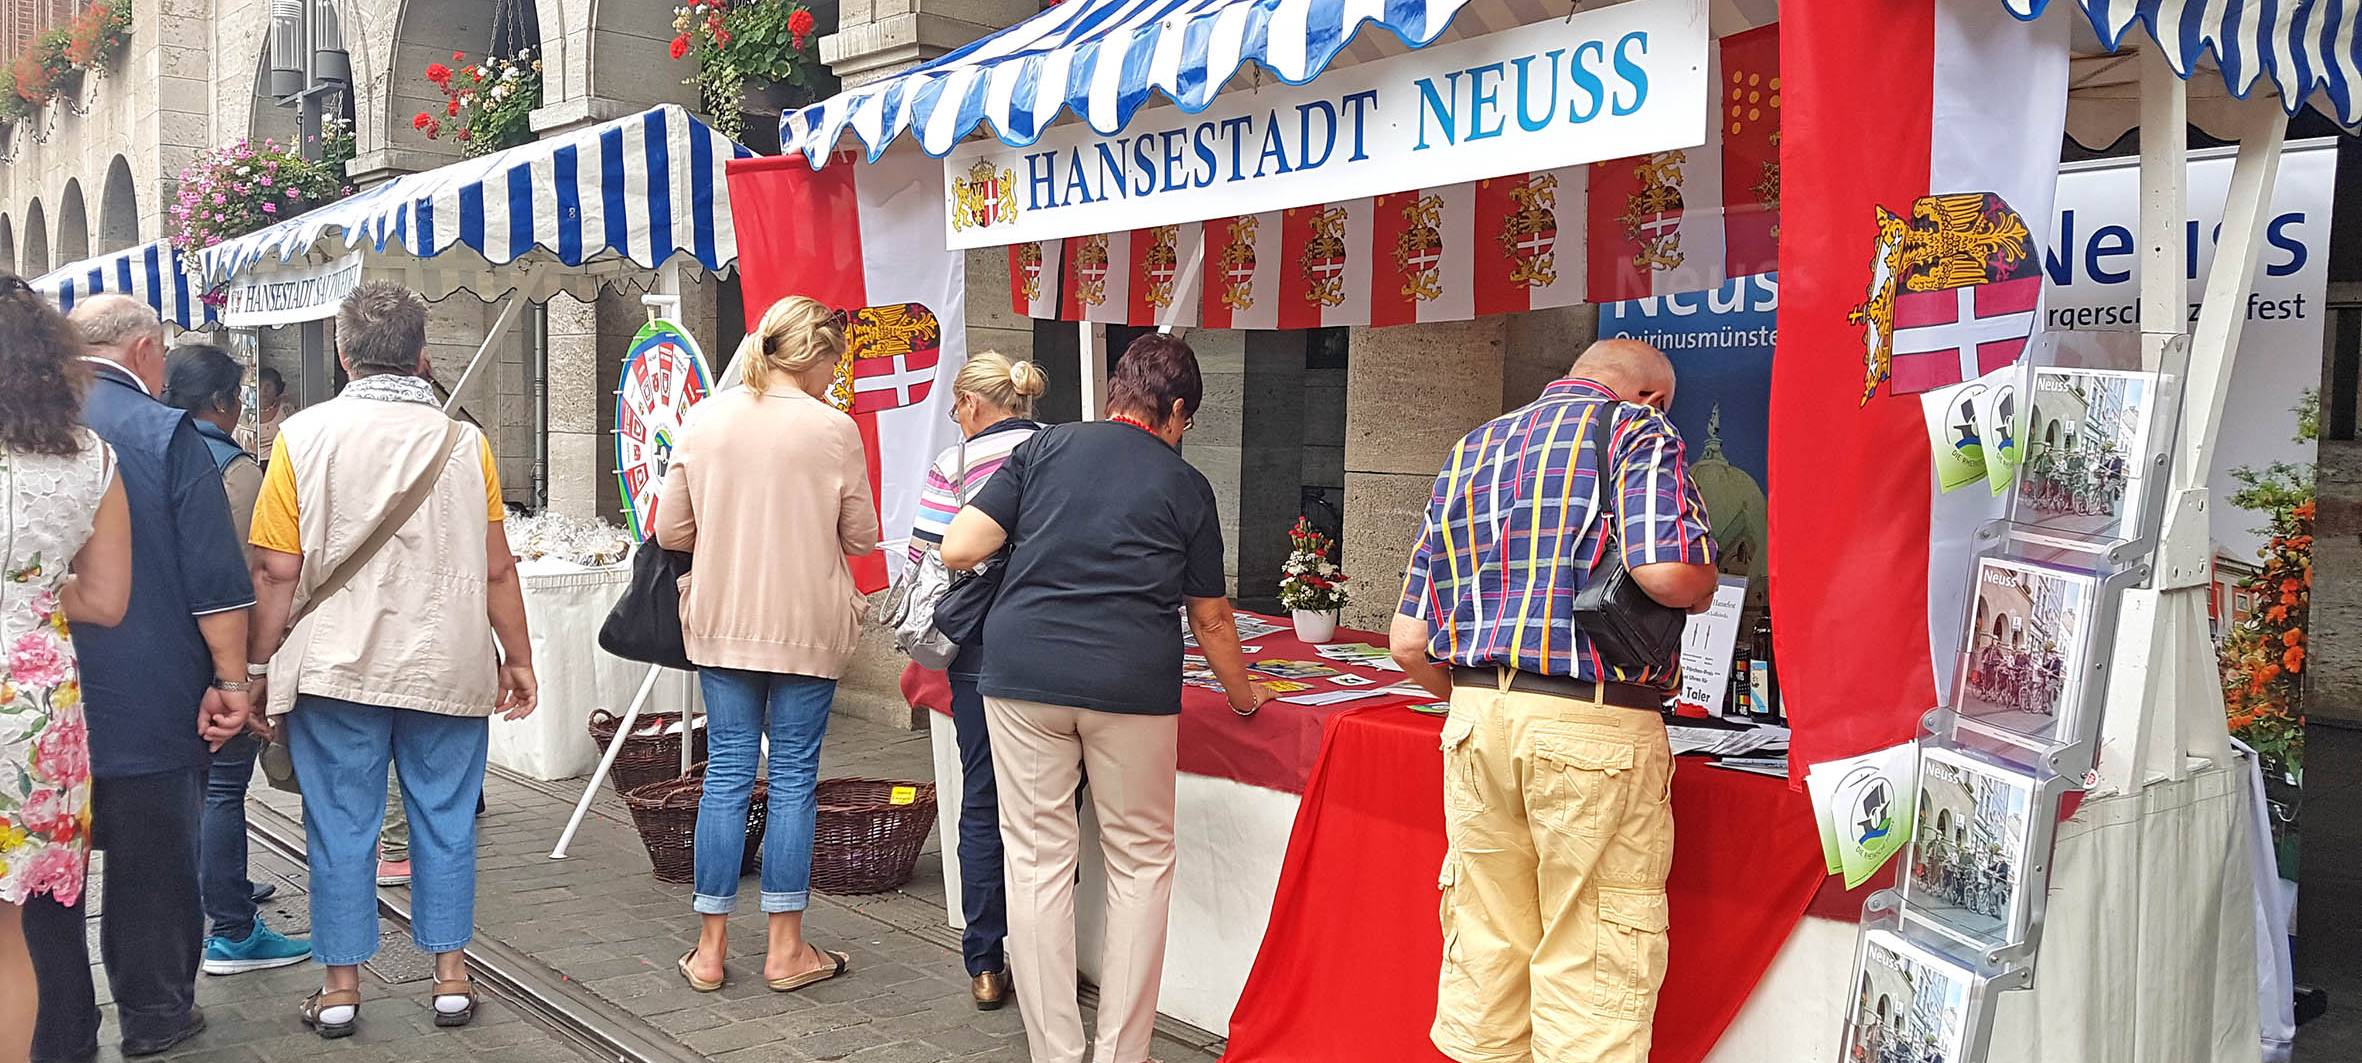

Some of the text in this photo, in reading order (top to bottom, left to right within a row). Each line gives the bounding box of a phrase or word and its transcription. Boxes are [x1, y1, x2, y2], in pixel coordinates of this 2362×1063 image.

[1024, 30, 1649, 212] HANSESTADT NEUSS
[2045, 209, 2309, 286] Nes
[244, 278, 316, 313] HANSESTADT
[1615, 257, 1778, 319] Neus
[2036, 377, 2070, 392] Neuss
[1983, 569, 2017, 588] Neuss
[1686, 686, 1711, 703] Taler
[1926, 762, 1960, 784] Neuss
[1868, 944, 1900, 971] Neuss
